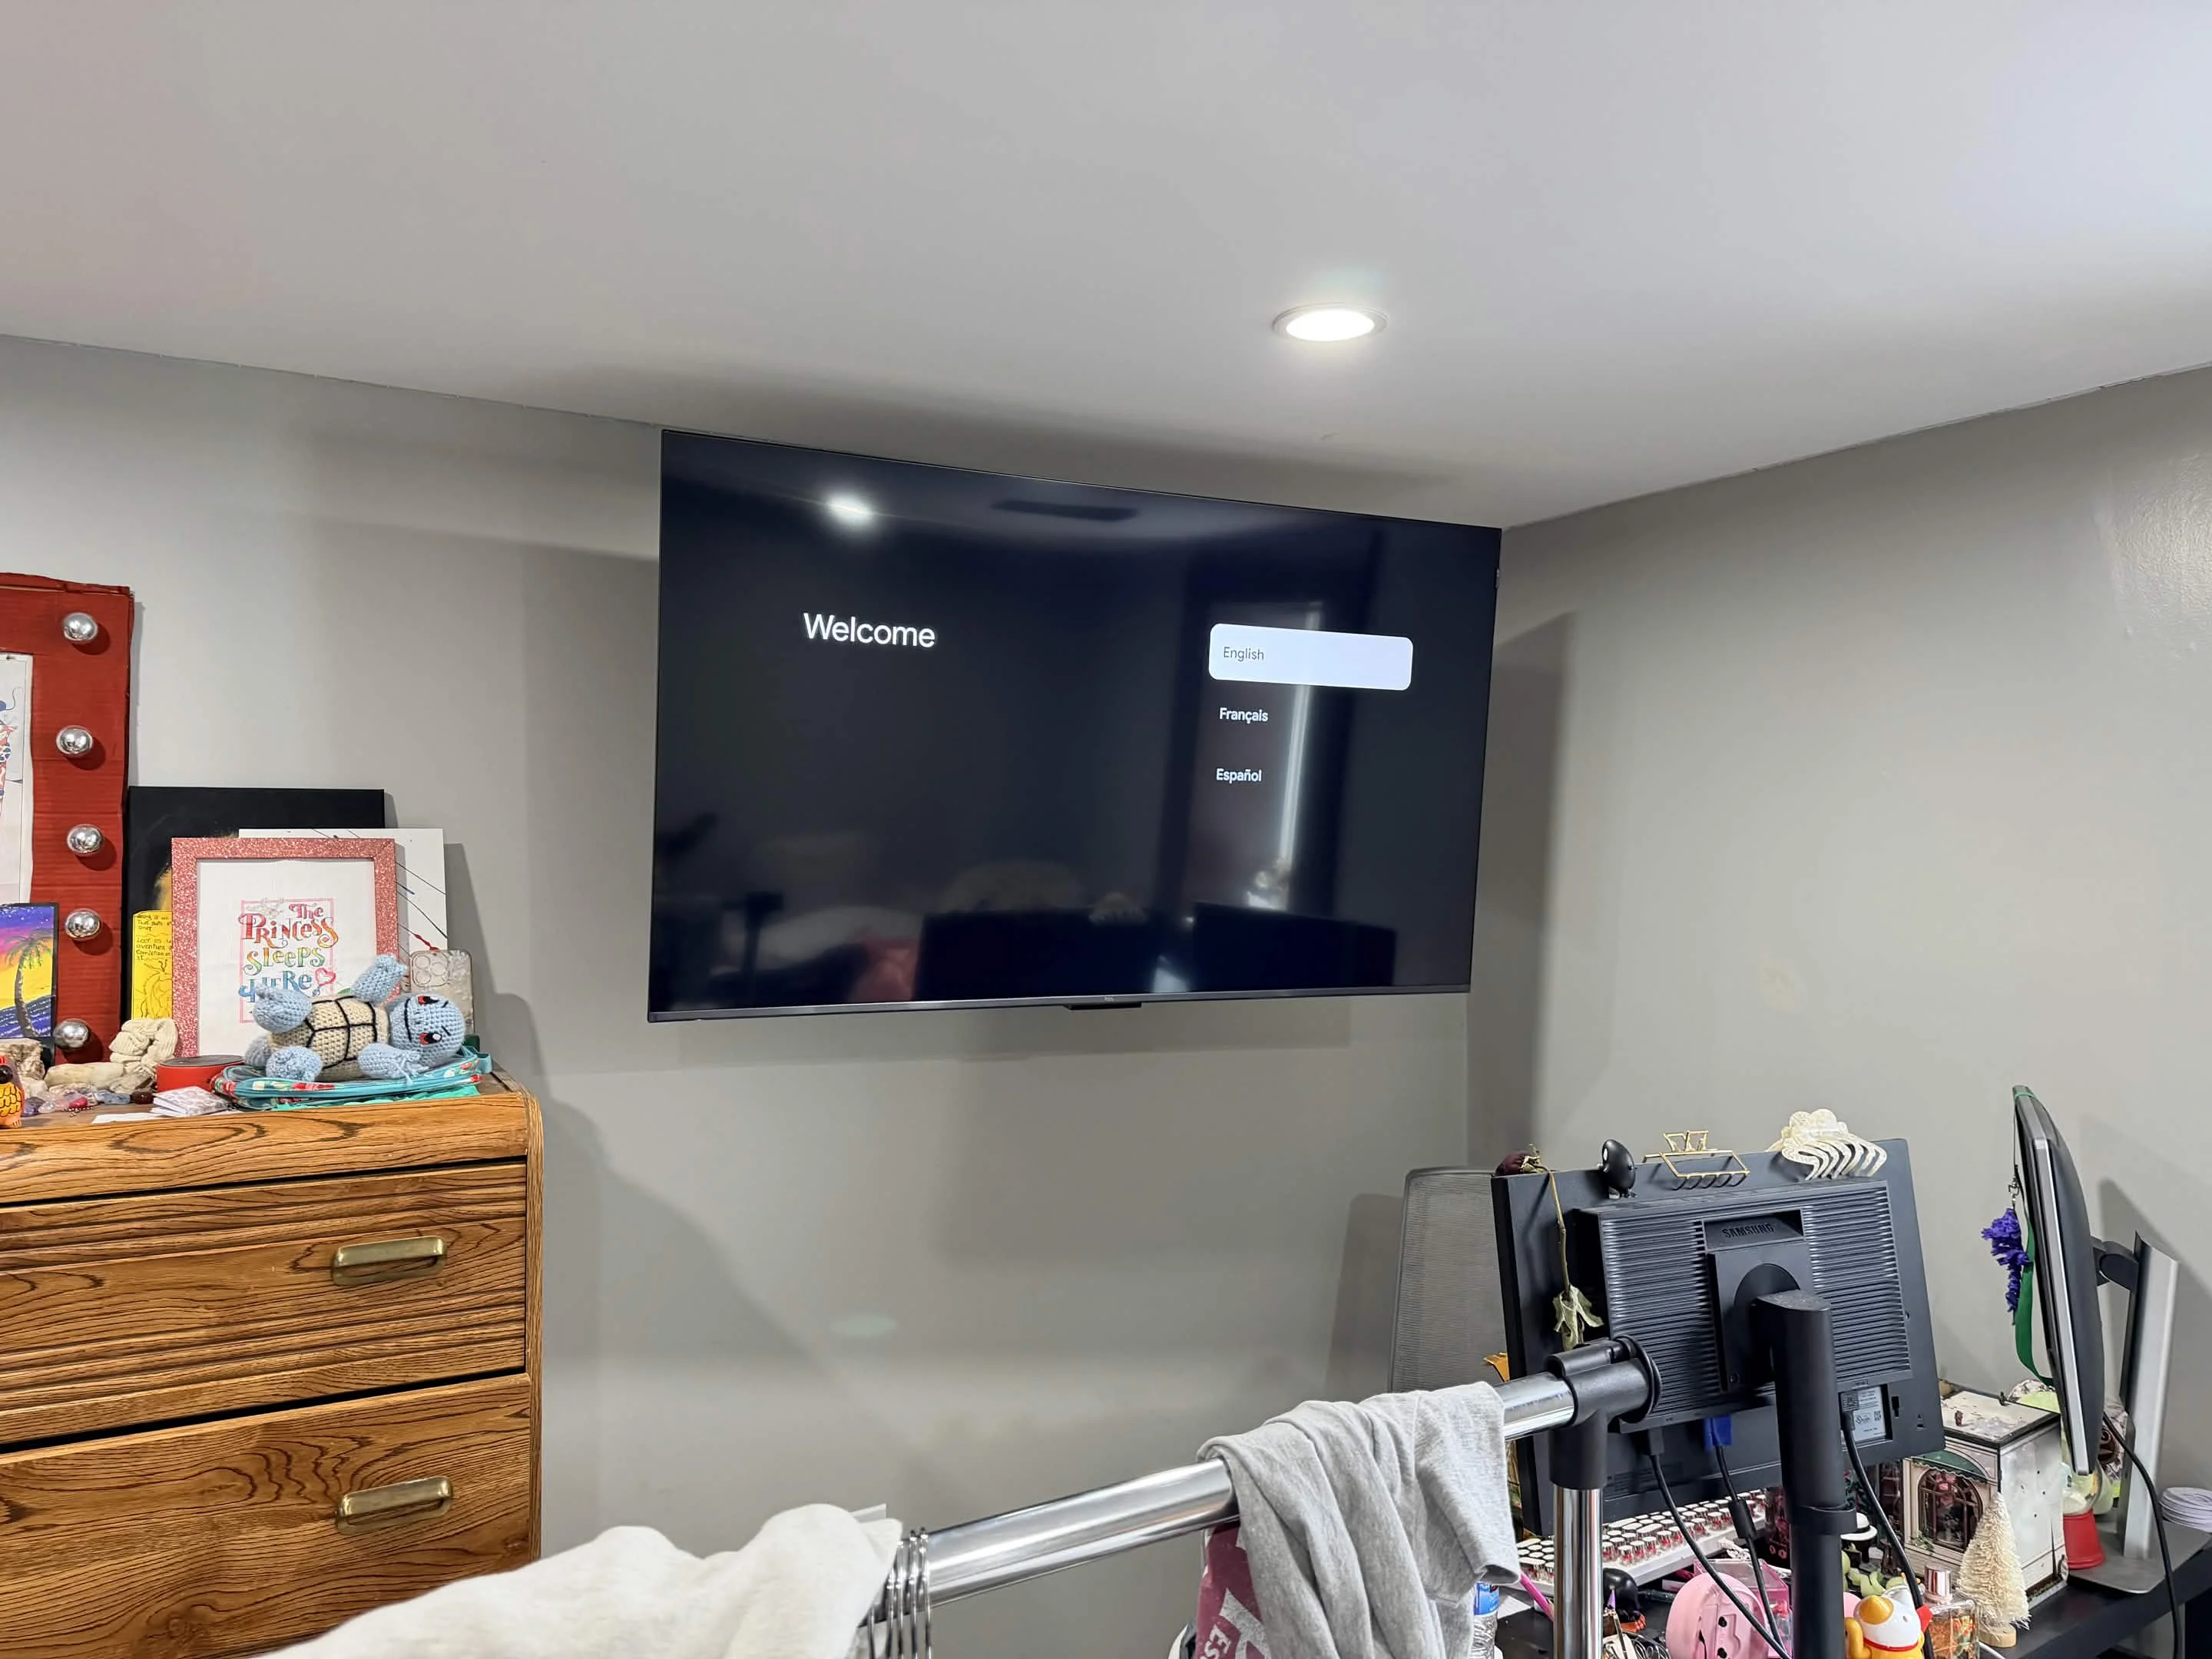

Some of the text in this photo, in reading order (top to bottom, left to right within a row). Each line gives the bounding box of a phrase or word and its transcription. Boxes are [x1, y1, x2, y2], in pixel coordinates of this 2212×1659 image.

[803, 612, 935, 647] Welcome
[1223, 646, 1265, 662] English
[1219, 707, 1269, 724] Français
[1216, 768, 1263, 784] Español
[289, 903, 324, 919] The
[1721, 1223, 1776, 1238] SAMSUNG
